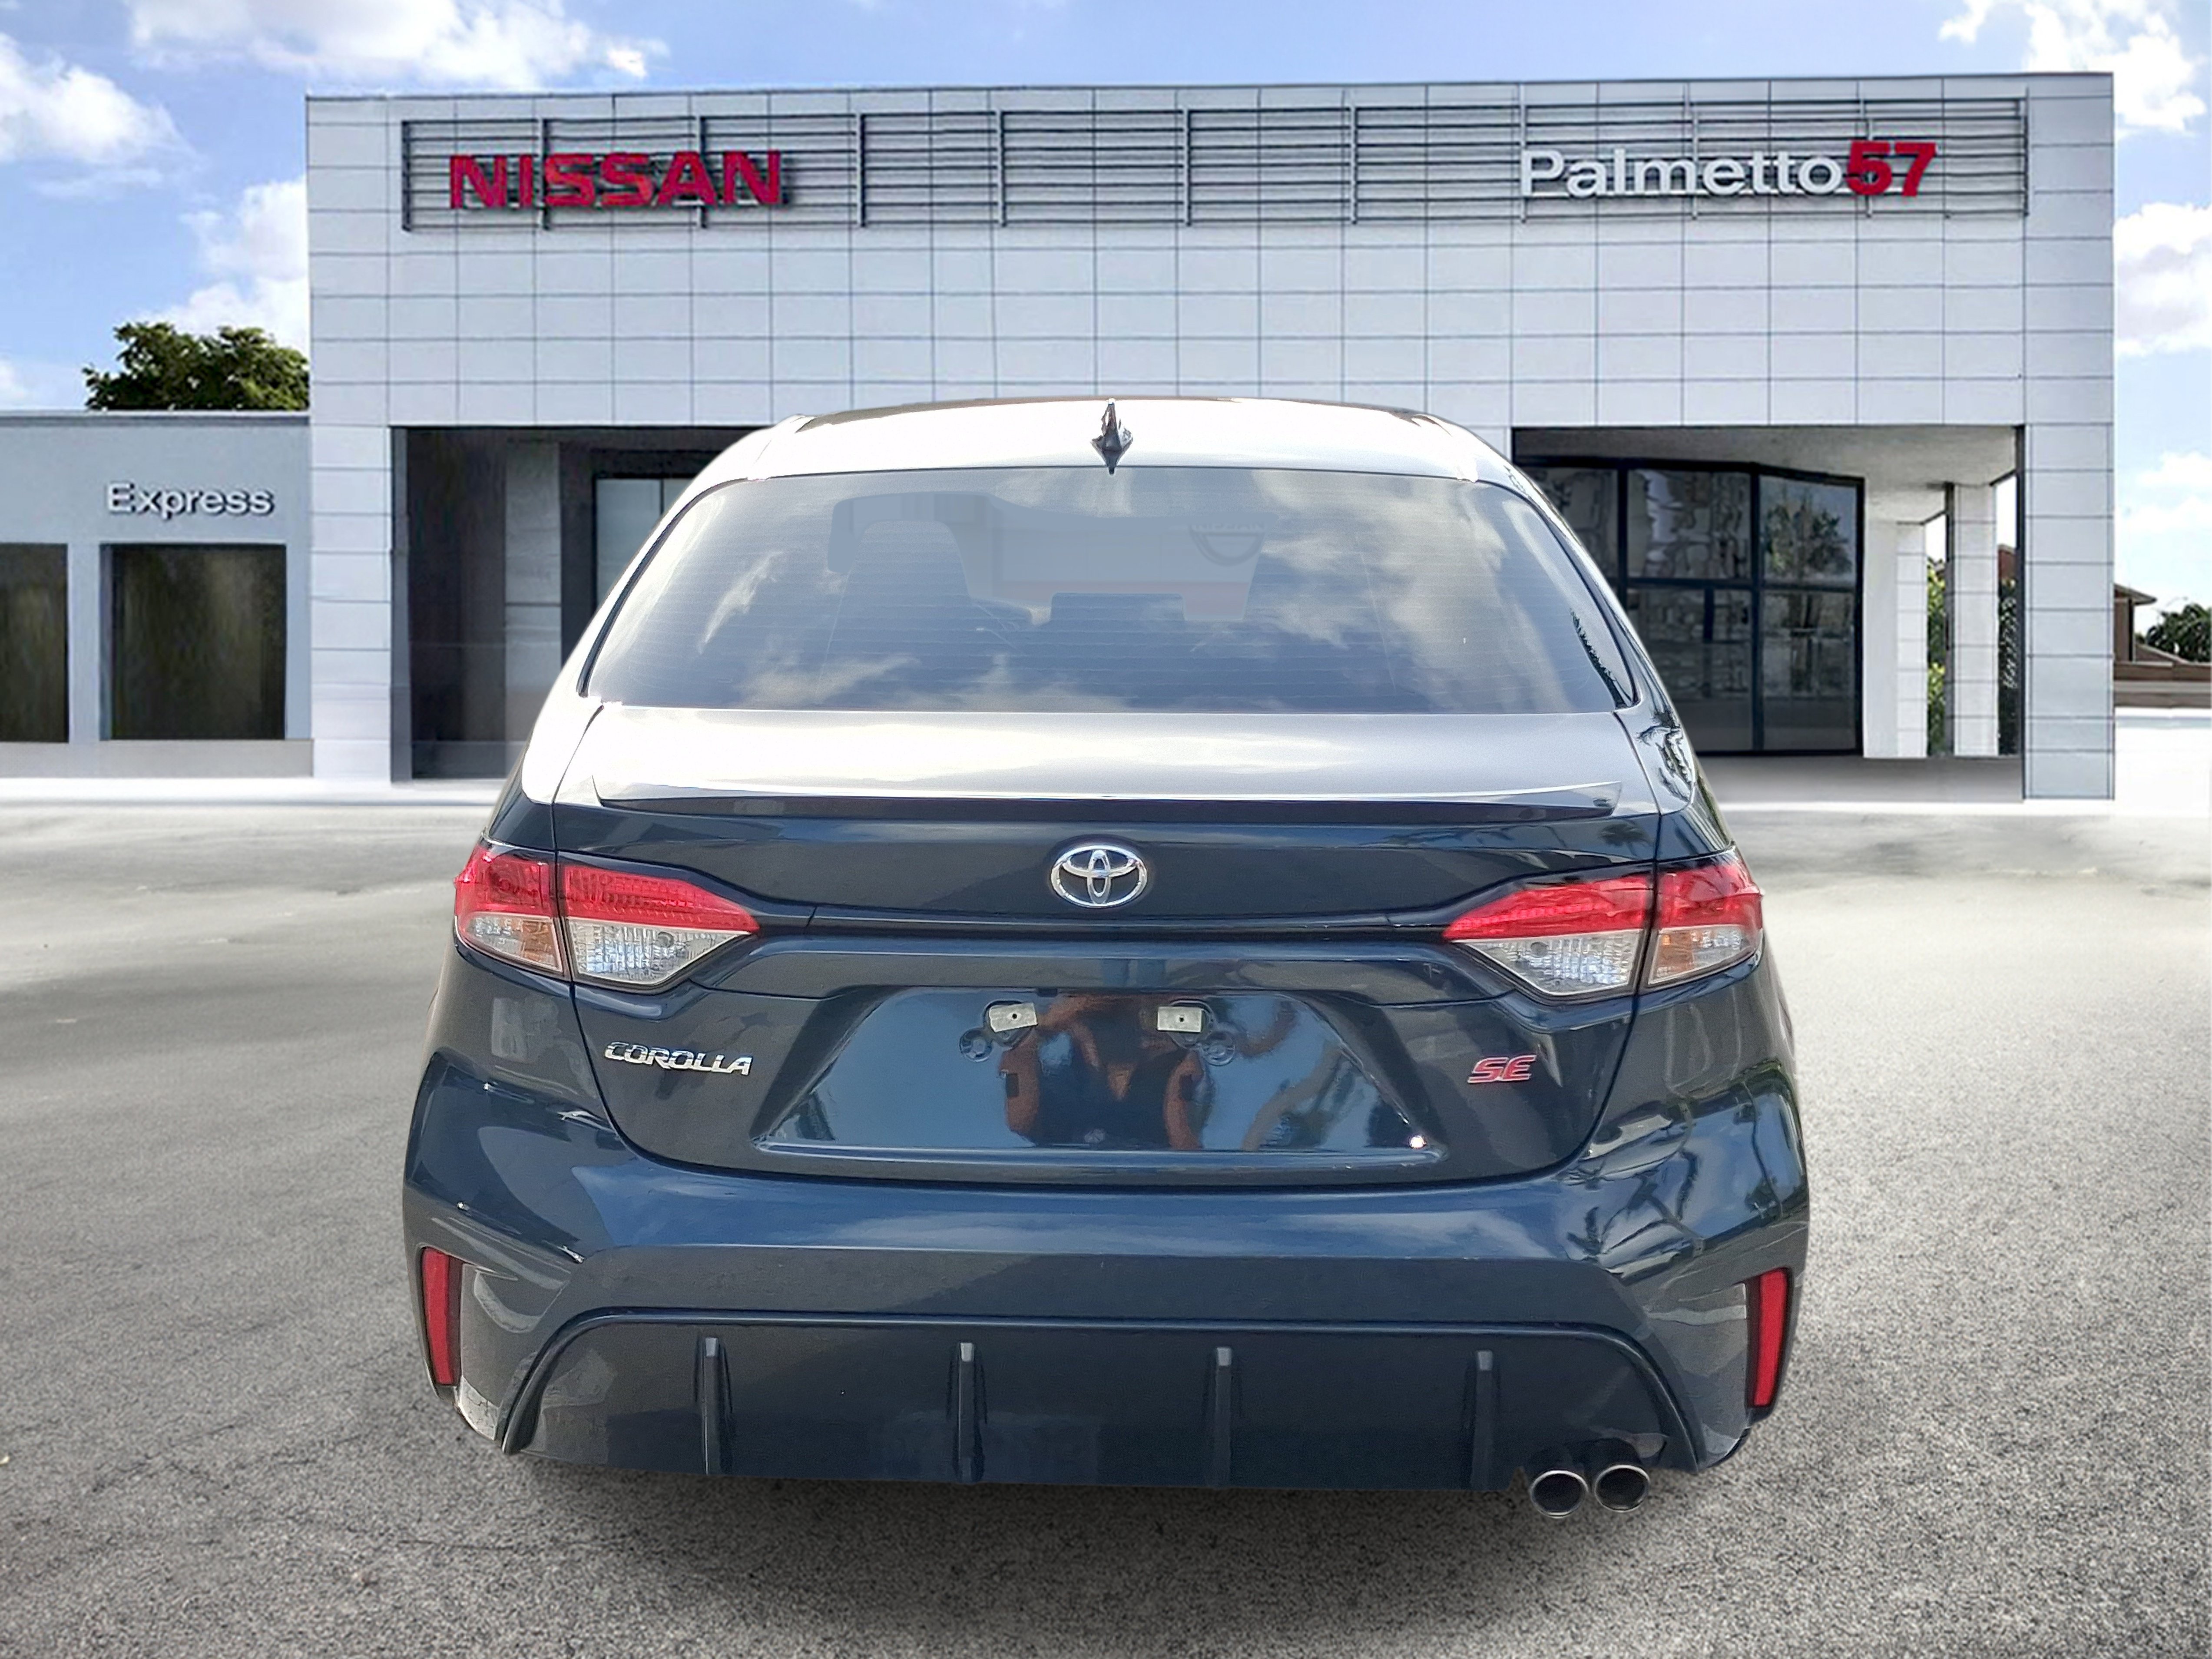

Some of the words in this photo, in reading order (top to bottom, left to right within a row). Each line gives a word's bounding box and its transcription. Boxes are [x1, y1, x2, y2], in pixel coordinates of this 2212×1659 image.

[450, 150, 781, 209] NISSAN
[107, 482, 274, 520] Express
[605, 1041, 753, 1076] COROLLA
[1467, 1054, 1537, 1083] SE
